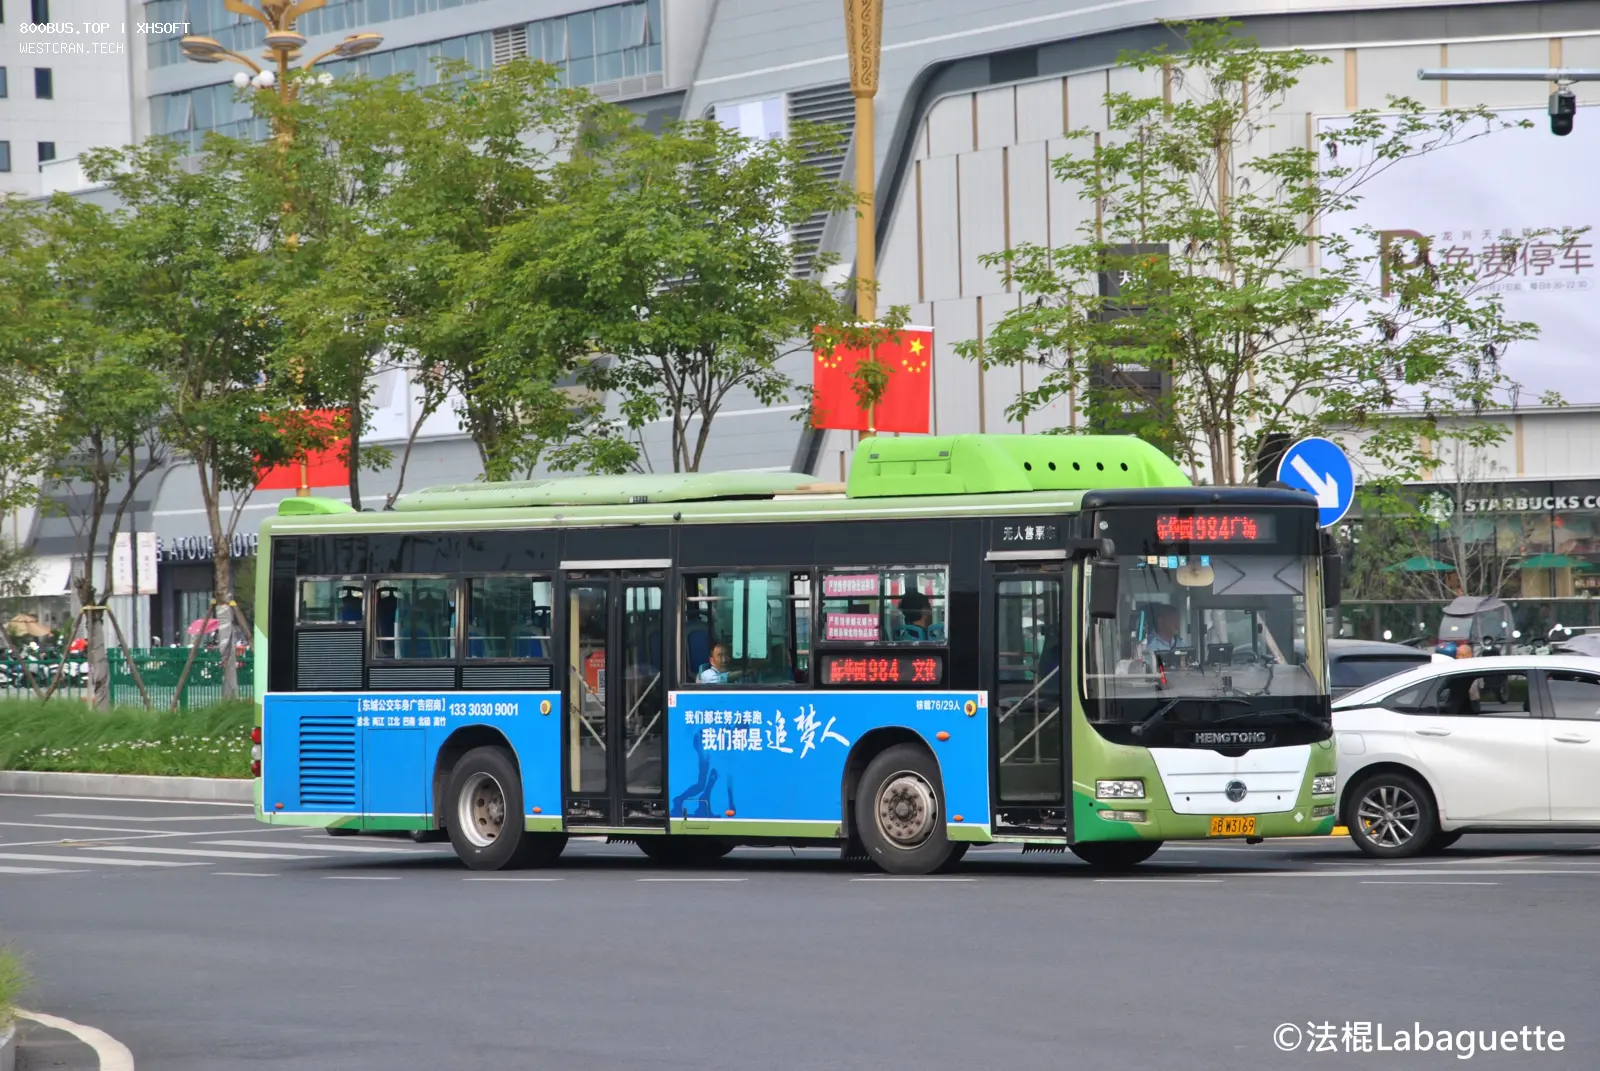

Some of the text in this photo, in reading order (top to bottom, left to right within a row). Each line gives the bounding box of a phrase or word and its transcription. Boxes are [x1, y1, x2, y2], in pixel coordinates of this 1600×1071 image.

[1444, 240, 1594, 278] 免费停车
[1465, 496, 1580, 512] STARBUCKS
[685, 710, 762, 725] 我们都在努力奔跑
[1195, 732, 1266, 744] HENGTONG
